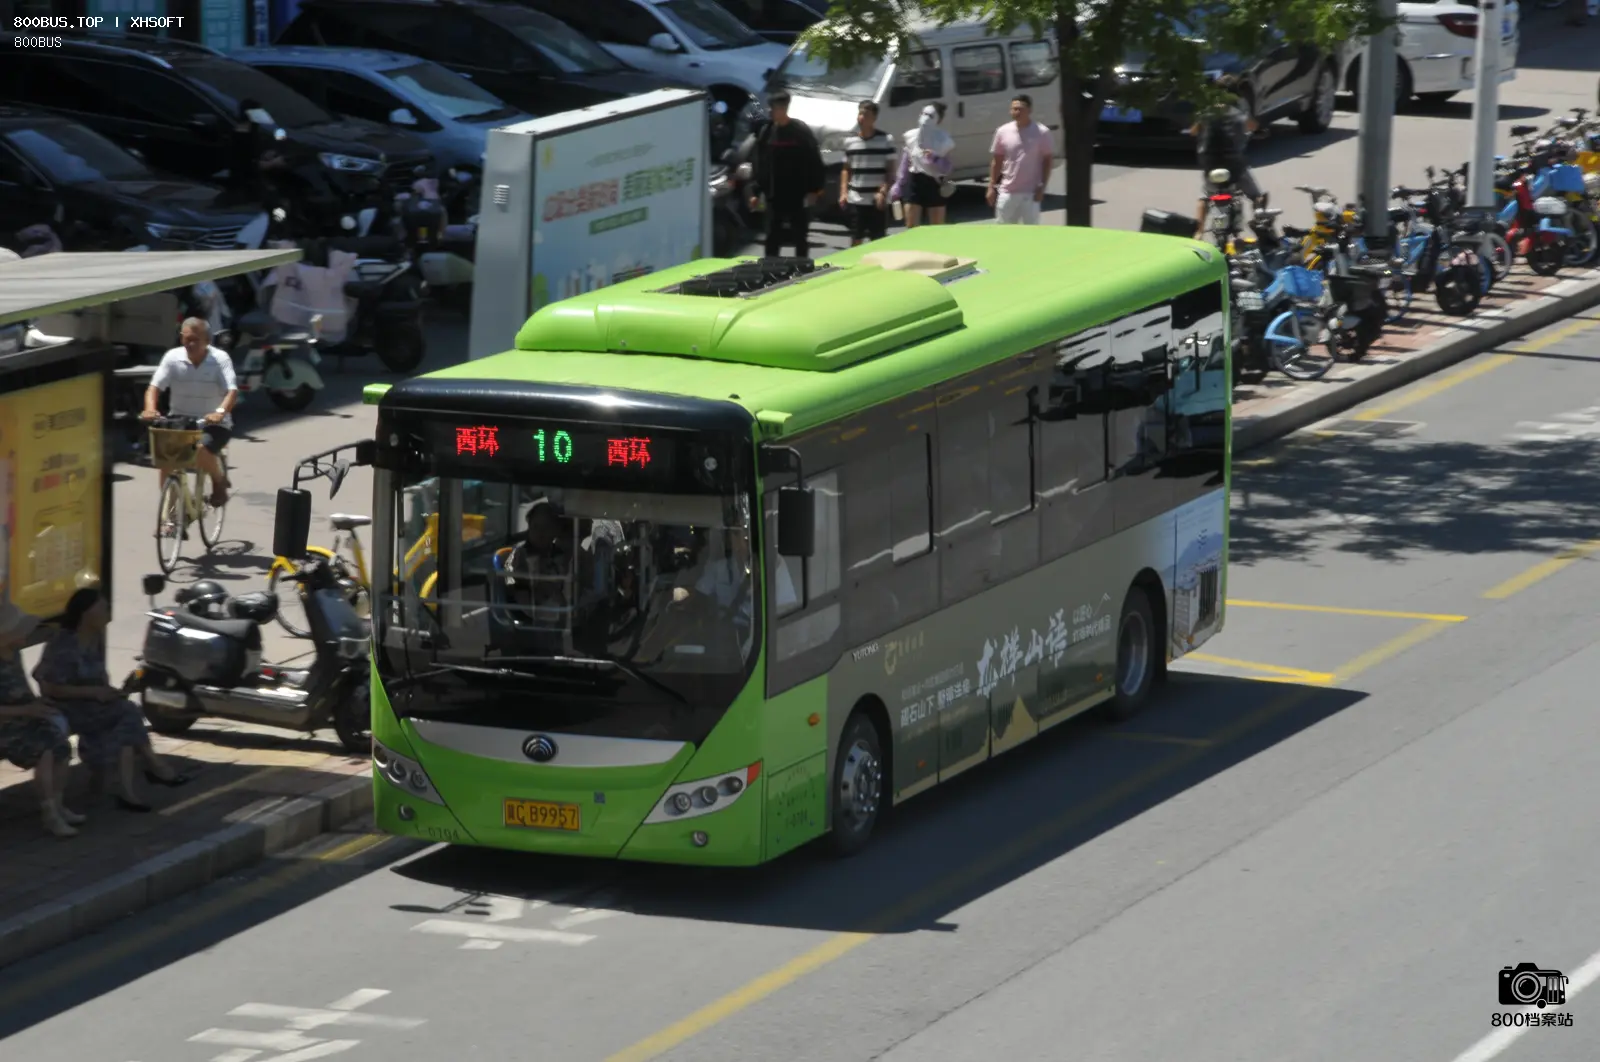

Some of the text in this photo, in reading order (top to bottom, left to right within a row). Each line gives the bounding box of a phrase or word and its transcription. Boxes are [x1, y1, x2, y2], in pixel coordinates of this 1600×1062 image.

[455, 424, 500, 458] 西环
[533, 428, 573, 463] 10
[607, 436, 651, 469] 西环
